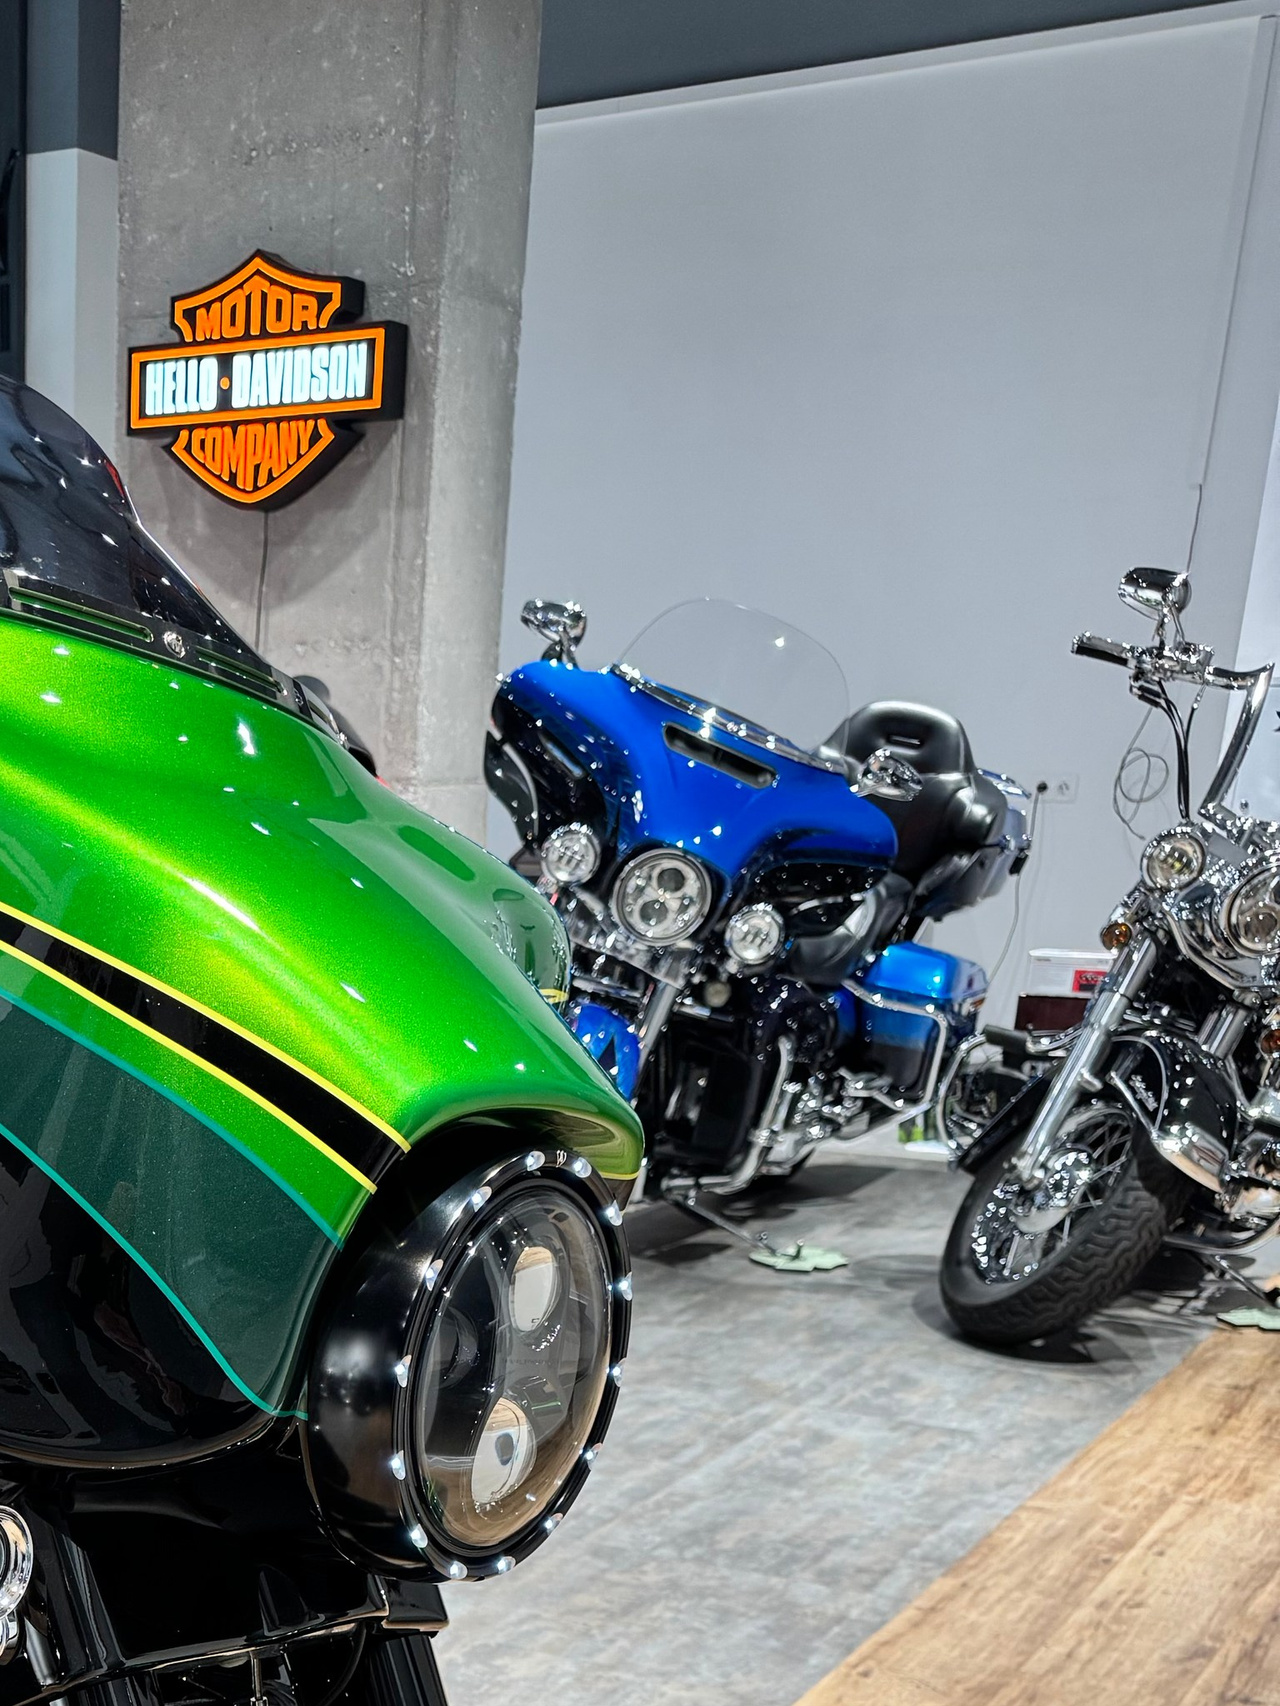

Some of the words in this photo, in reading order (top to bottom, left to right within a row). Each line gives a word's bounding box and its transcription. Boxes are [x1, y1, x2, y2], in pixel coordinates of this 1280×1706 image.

[195, 274, 318, 341] MOTOR
[145, 356, 218, 416] HELLO
[231, 342, 368, 408] DAVIDSON
[191, 419, 315, 491] COMPANY
